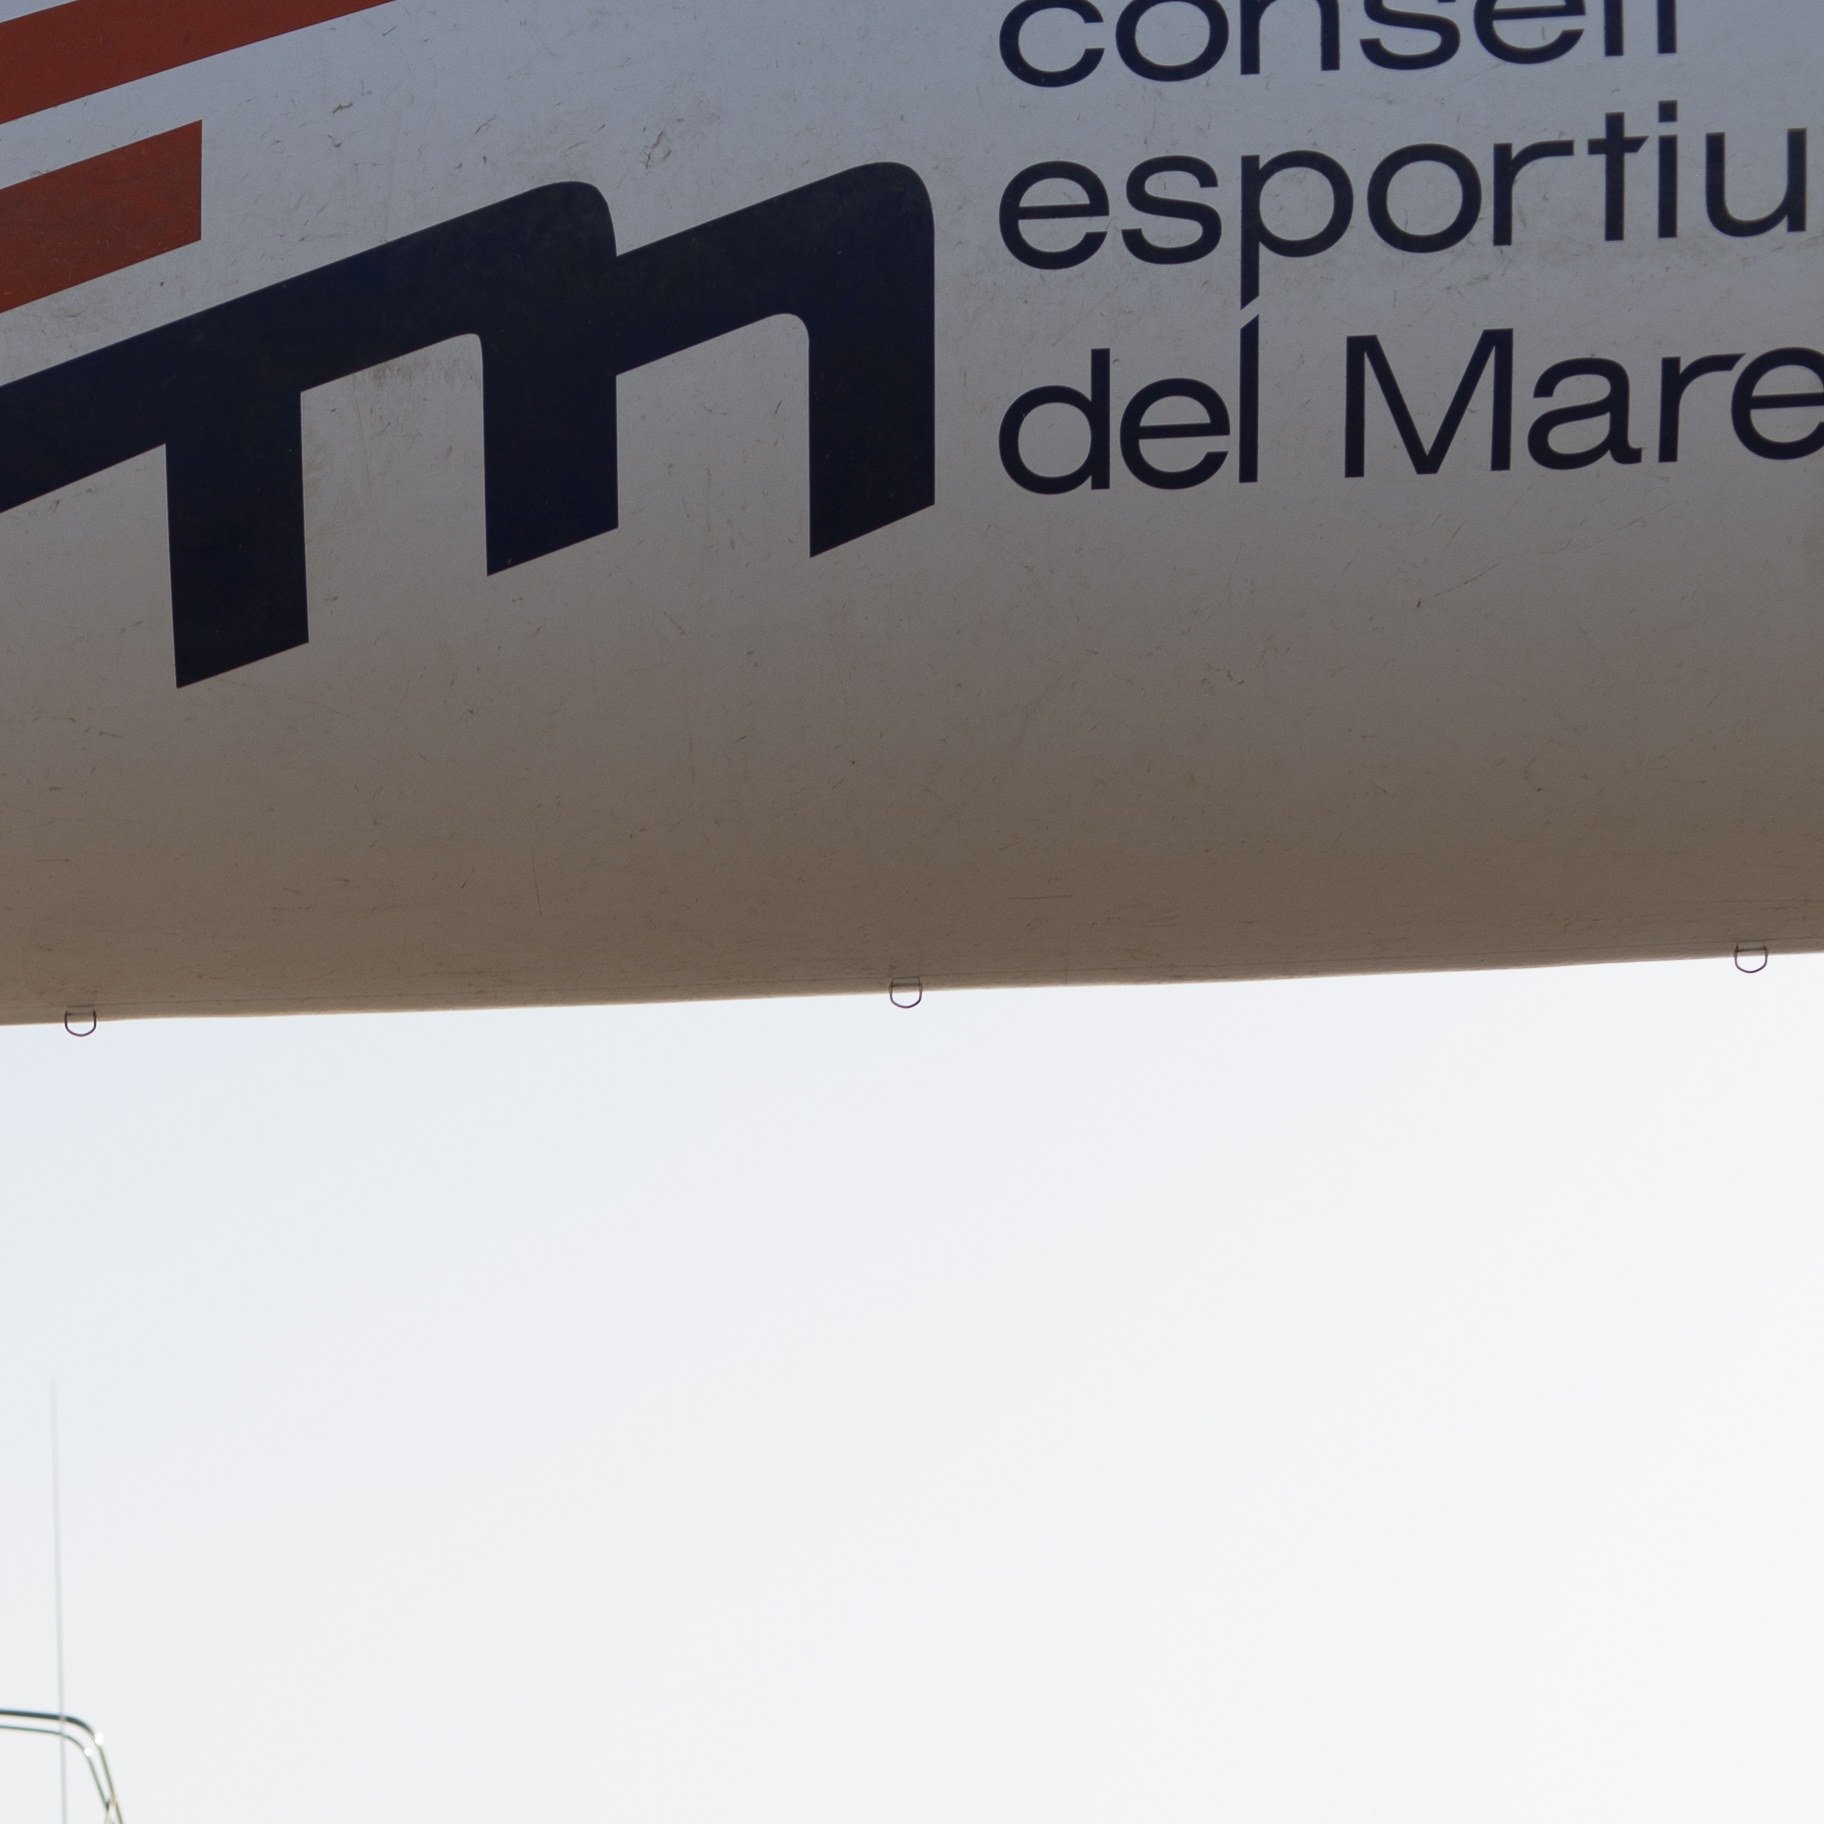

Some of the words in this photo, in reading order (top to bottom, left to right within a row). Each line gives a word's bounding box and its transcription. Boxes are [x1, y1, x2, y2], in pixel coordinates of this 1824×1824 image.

[999, 99, 1808, 310] esportiu
[998, 314, 1260, 495] del
[1344, 327, 1824, 478] Mare
